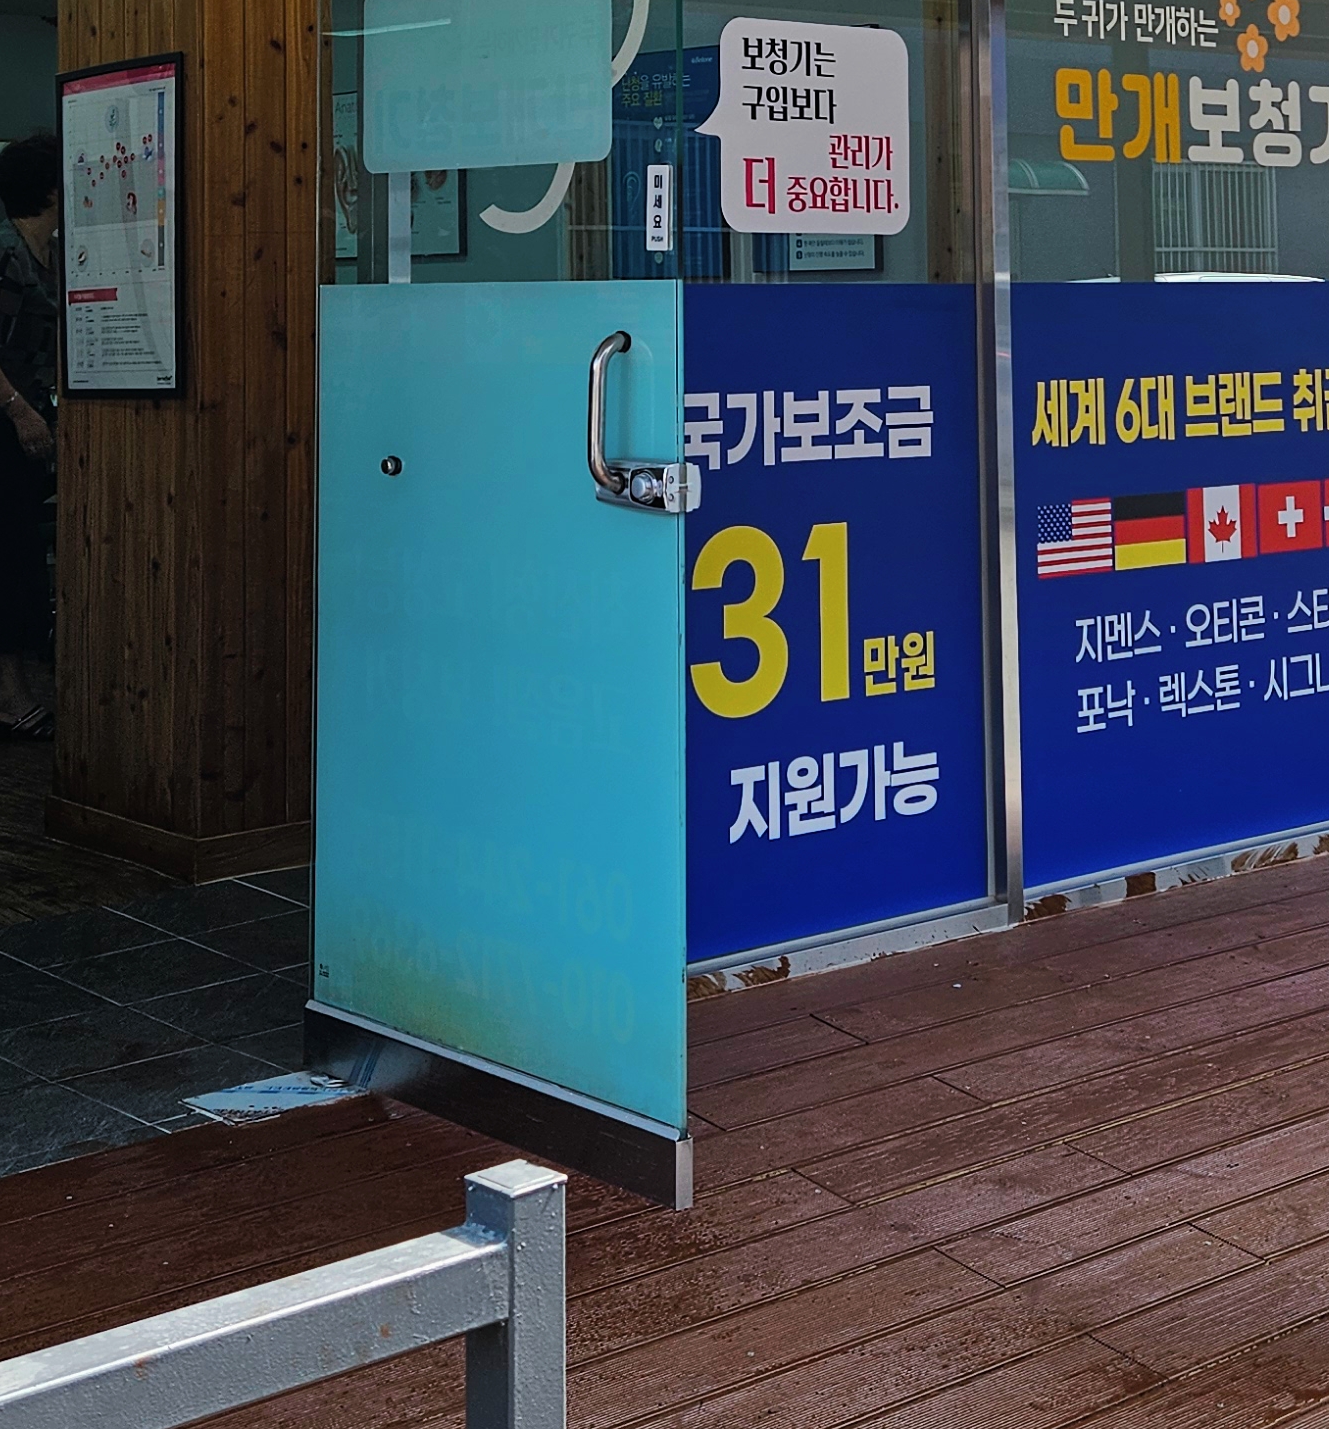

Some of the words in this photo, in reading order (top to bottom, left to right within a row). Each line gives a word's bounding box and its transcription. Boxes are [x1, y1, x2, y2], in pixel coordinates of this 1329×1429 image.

[741, 36, 837, 78] 보청기는
[1134, 3, 1219, 48] 만개하는
[741, 85, 838, 125] 구입보다
[828, 134, 894, 172] 관리가
[743, 156, 776, 214] 더
[786, 176, 900, 214] 중요합니다.
[684, 385, 935, 471] 국가보조금
[1031, 378, 1106, 449] 세계
[1114, 373, 1175, 445] 6대
[1184, 370, 1286, 438] 브랜드
[1075, 610, 1162, 664] 지멘스
[1185, 595, 1267, 649] 오티콘
[1076, 678, 1135, 735] 포낙
[1158, 663, 1242, 719] 렉스톤
[728, 740, 940, 845] 지원가능
